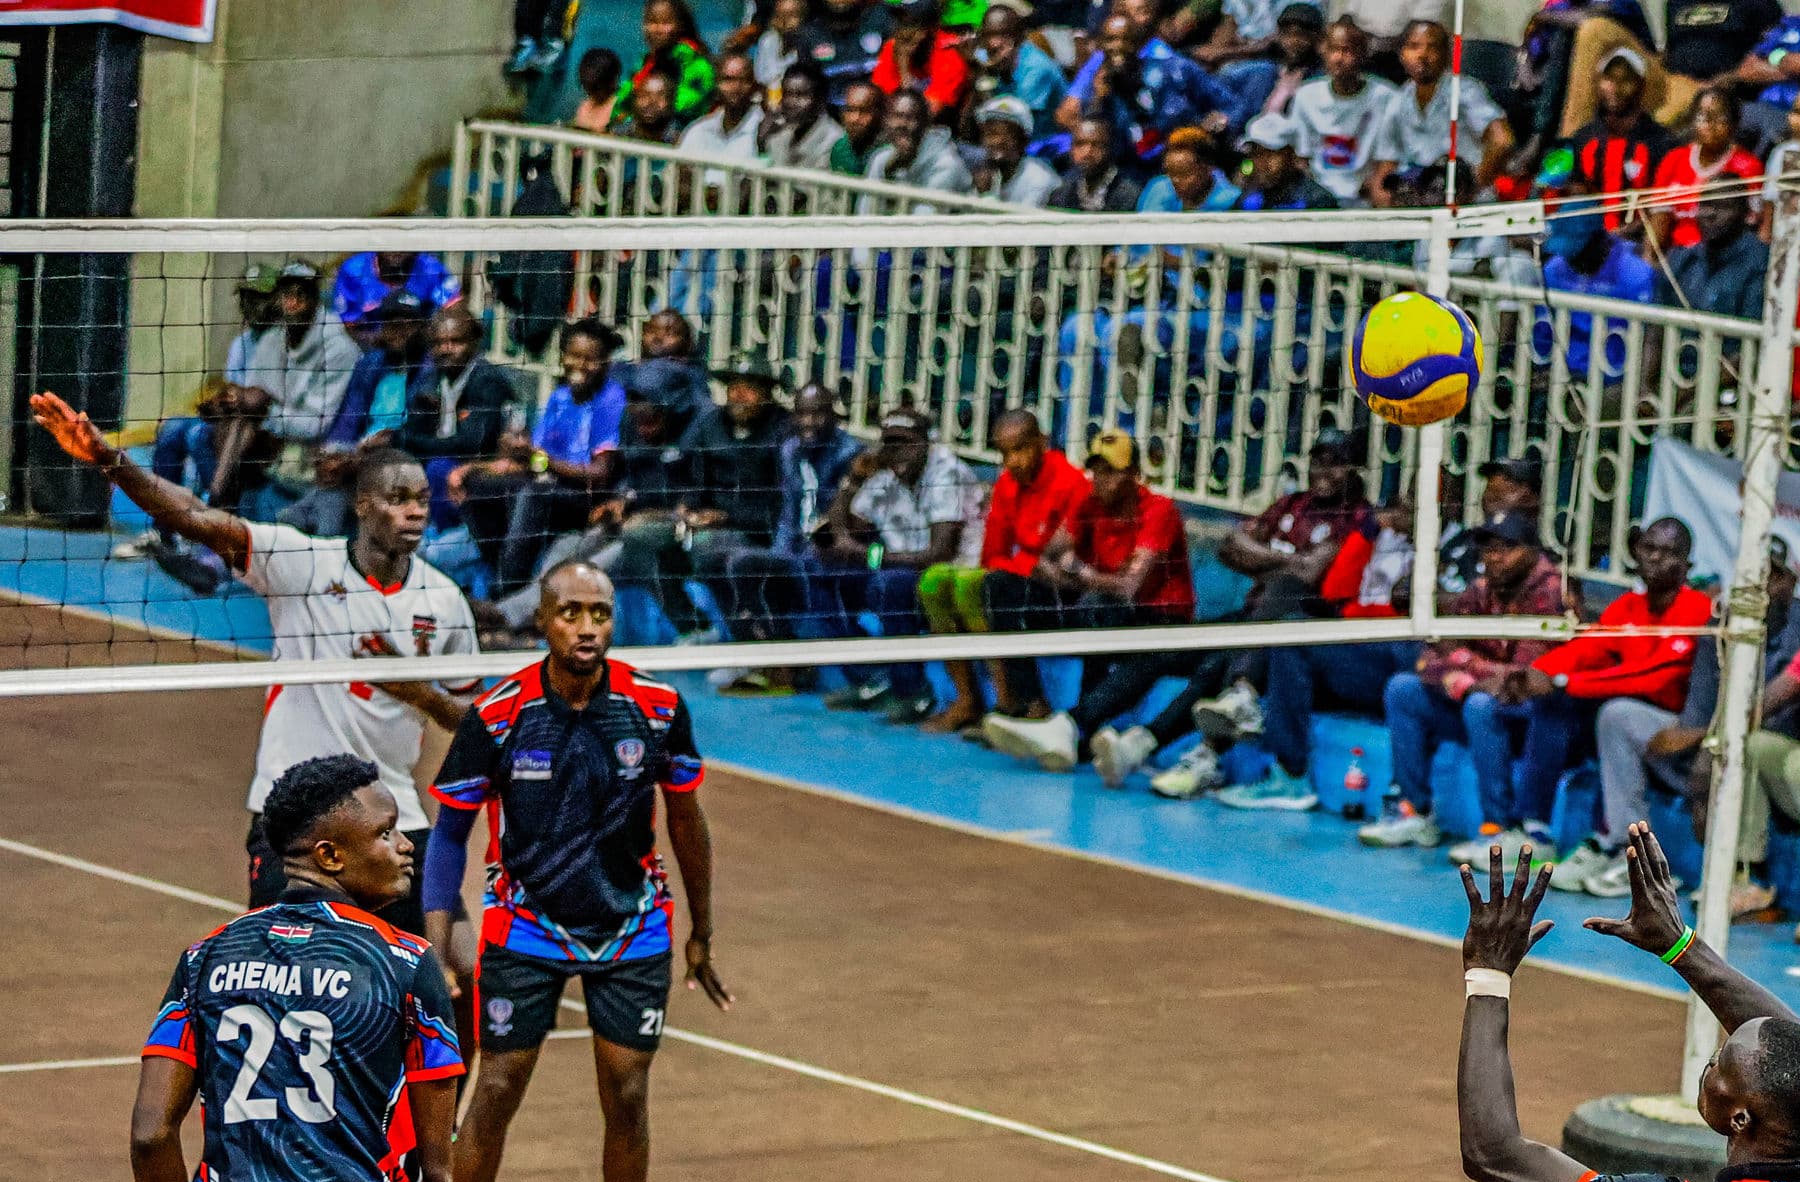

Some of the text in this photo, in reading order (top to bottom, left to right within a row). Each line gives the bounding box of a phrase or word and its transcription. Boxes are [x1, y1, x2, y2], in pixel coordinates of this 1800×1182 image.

[208, 961, 352, 999] CHEMA VC
[638, 1007, 664, 1036] 21
[216, 1003, 337, 1125] 23
